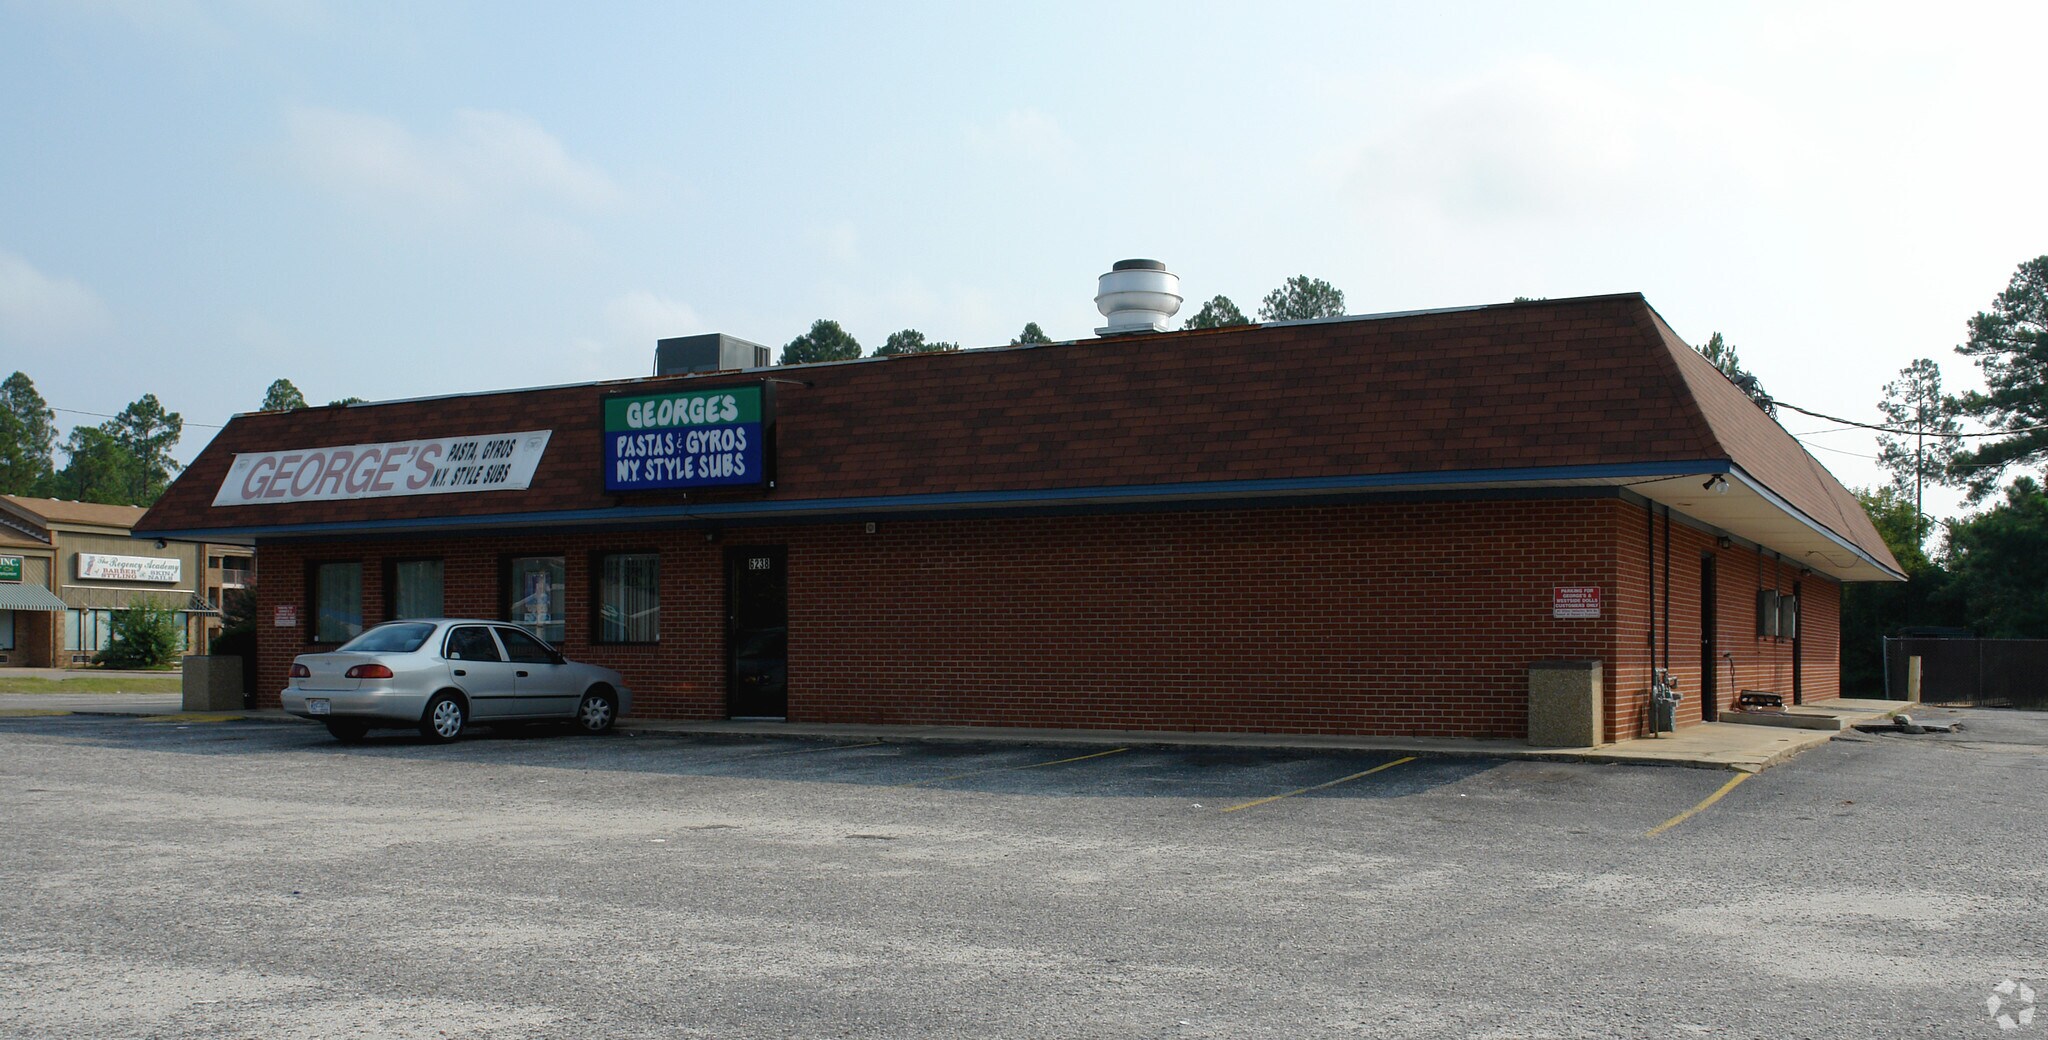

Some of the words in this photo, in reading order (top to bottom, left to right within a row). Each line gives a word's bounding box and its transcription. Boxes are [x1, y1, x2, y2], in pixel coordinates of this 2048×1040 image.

[626, 394, 739, 429] GEORGE'S
[446, 441, 479, 464] PASTA,
[481, 439, 517, 460] GYROS
[616, 432, 673, 458] PASTAS
[685, 427, 747, 454] GYROS
[241, 443, 443, 500] GEORGE'S
[430, 467, 450, 487] N.Y.
[450, 465, 484, 486] STYLE
[482, 463, 512, 484] SUBS
[616, 459, 640, 483] N.Y.
[644, 456, 695, 481] STYLE
[697, 452, 746, 478] SUBS
[97, 556, 109, 565] The
[109, 556, 143, 572] Regency
[144, 559, 179, 574] Academy
[102, 567, 137, 575] BARBER
